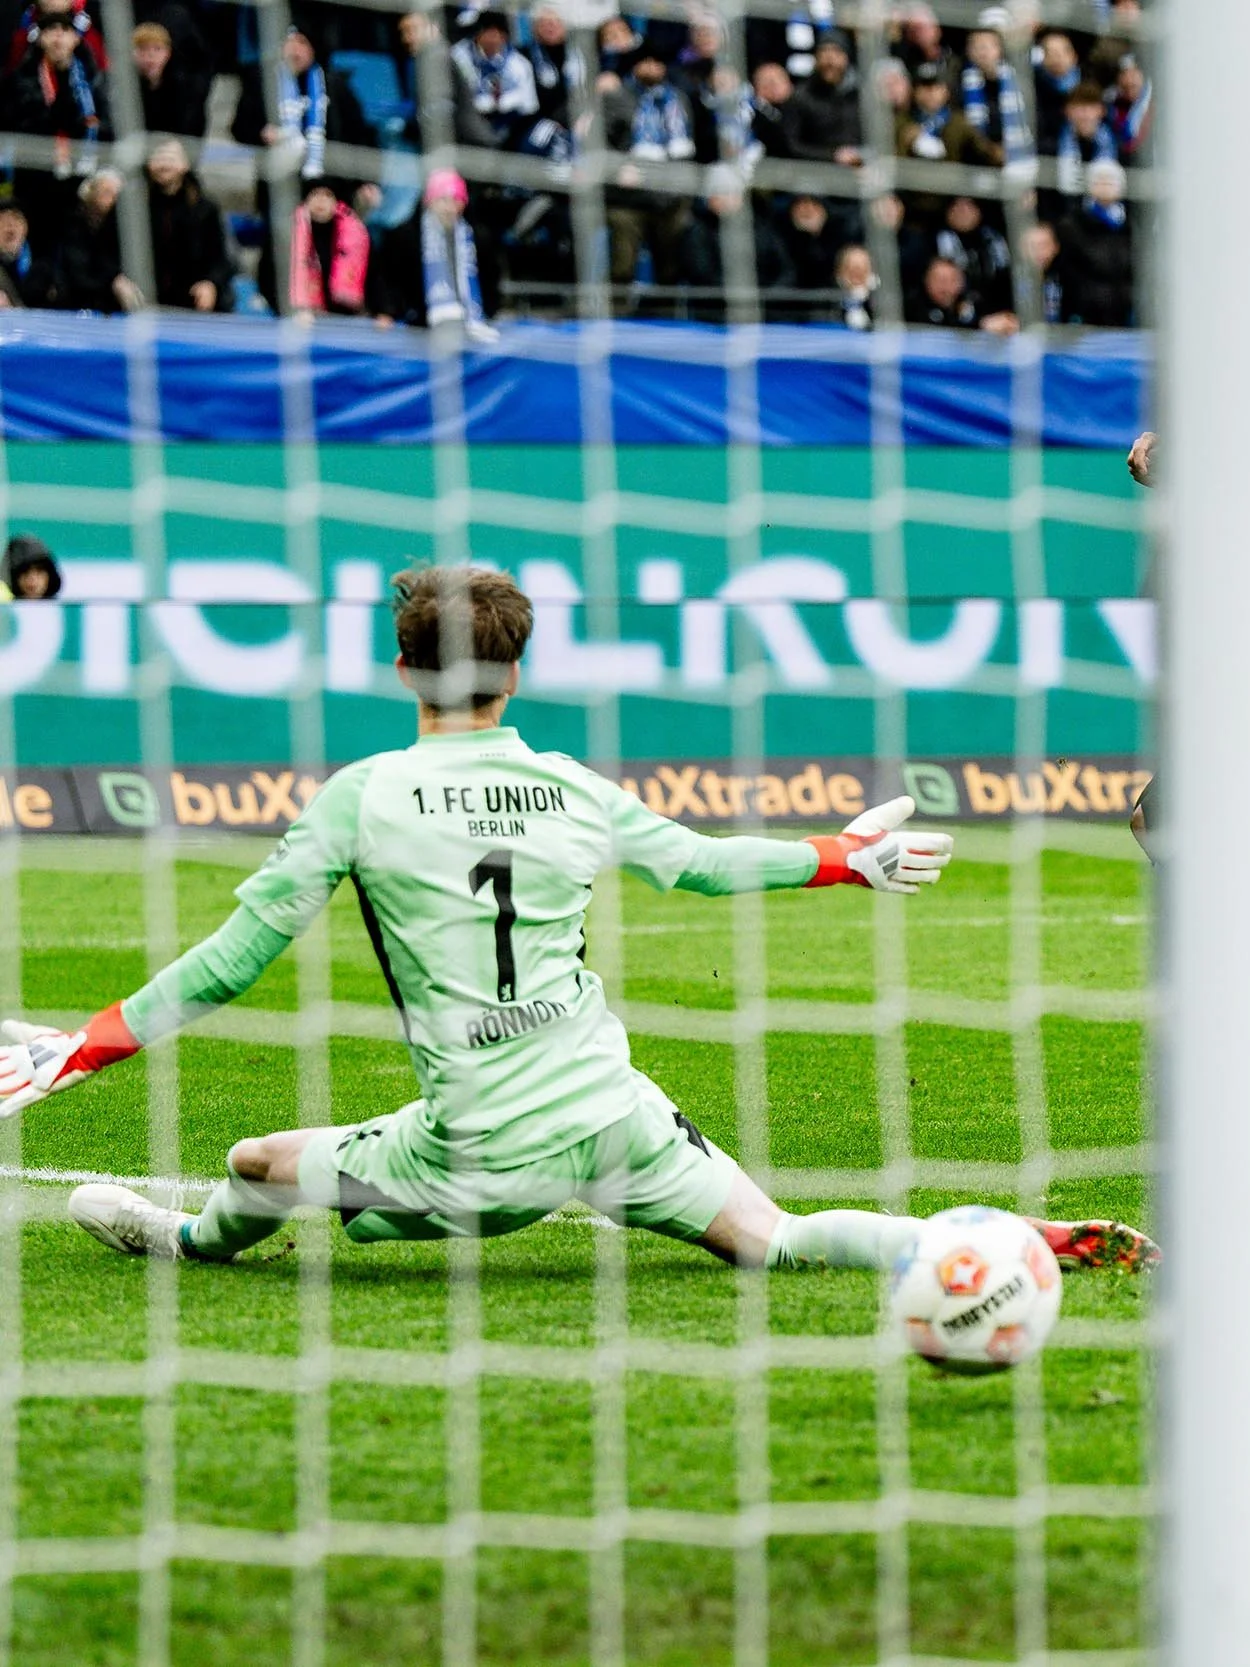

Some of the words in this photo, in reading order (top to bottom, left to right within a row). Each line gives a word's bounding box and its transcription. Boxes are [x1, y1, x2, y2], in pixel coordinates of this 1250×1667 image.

[412, 787, 435, 815] 1.
[443, 787, 475, 813] FC
[485, 786, 567, 813] UNION
[621, 763, 866, 818] uXtrade
[467, 819, 526, 838] BERLIN
[468, 849, 517, 1003] 1
